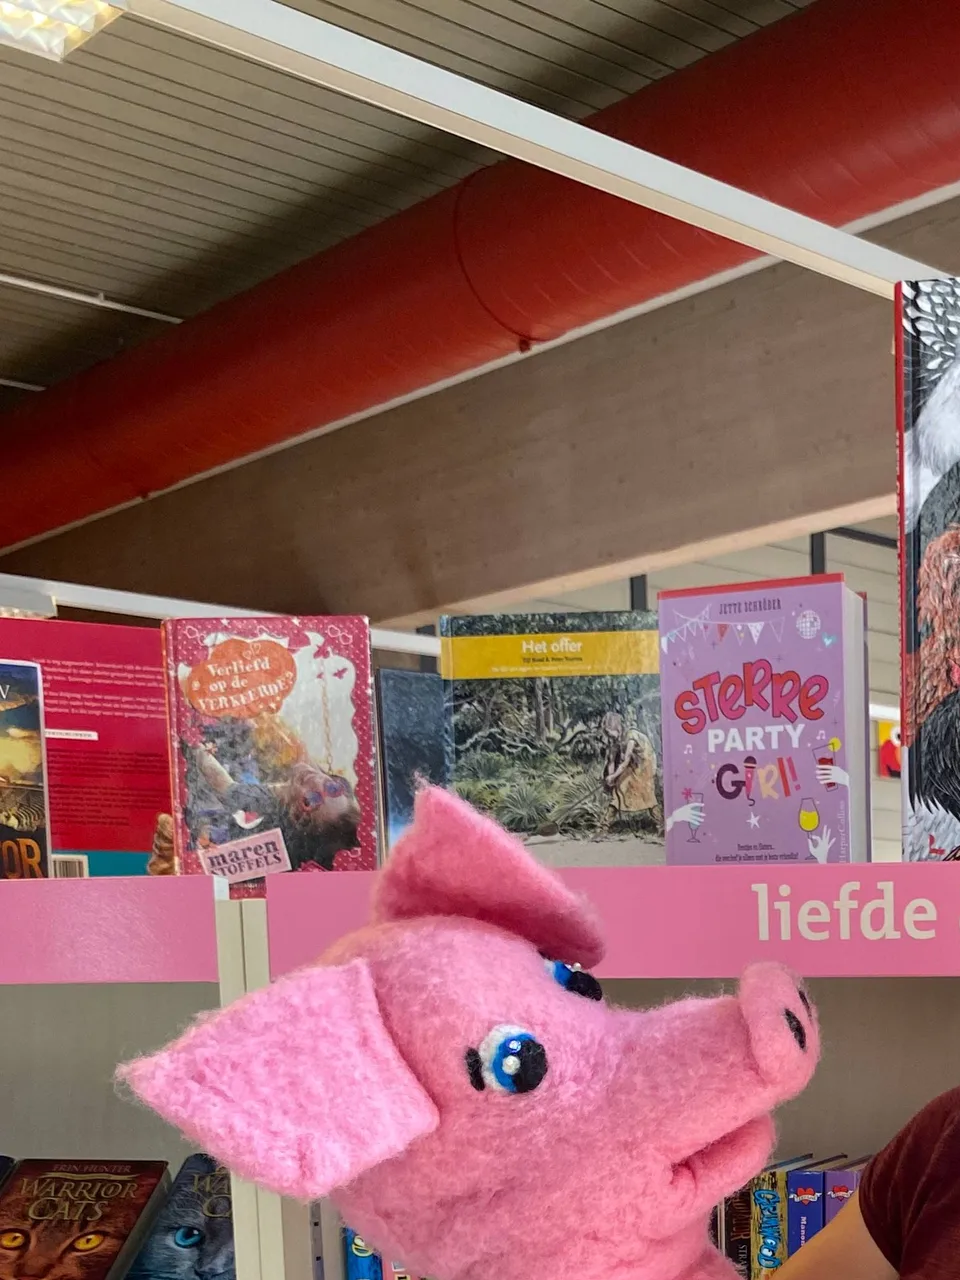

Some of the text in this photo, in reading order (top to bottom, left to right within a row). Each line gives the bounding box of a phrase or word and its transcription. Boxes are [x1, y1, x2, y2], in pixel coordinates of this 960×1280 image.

[719, 602, 742, 615] JETTE
[522, 637, 583, 653] Het offer
[207, 657, 271, 677] Verliefd
[209, 675, 248, 692] op de
[708, 724, 805, 753] PARTY
[207, 838, 279, 866] maren
[751, 880, 937, 941] liefde
[53, 1164, 132, 1173] ERIN HUNTER
[19, 1178, 140, 1199] WARRIOR
[28, 1198, 109, 1221] CATS
